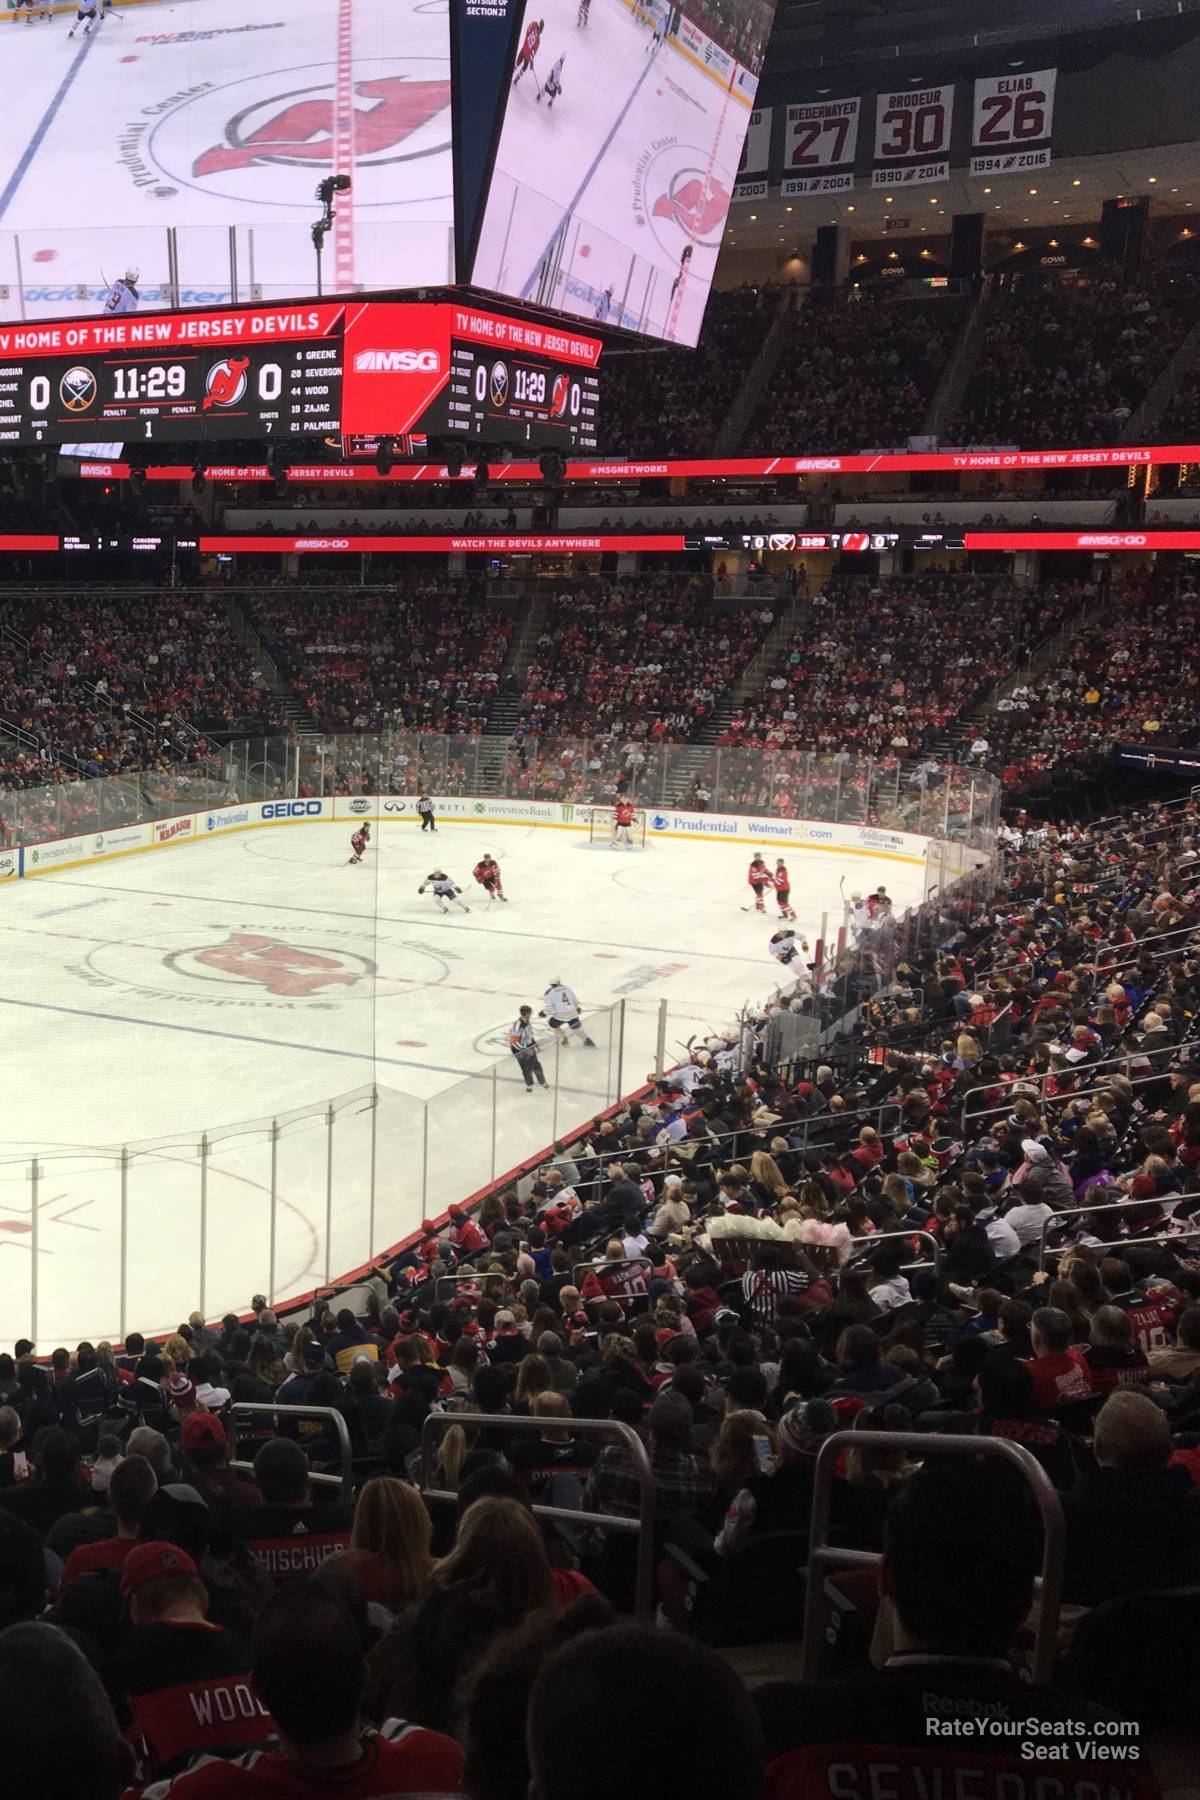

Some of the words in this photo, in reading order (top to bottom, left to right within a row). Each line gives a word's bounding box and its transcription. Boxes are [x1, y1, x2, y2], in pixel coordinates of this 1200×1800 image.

[466, 7, 493, 16] SECTION
[141, 81, 215, 116] Center
[889, 90, 941, 109] BRODEUR
[789, 102, 857, 121] NIEDERMAYER
[980, 91, 1046, 143] 26
[882, 105, 945, 156] 30
[792, 117, 850, 165] 27
[115, 122, 160, 188] Prudential
[974, 160, 1000, 171] 1994
[1018, 153, 1047, 166] 2016
[875, 171, 902, 182] 1990
[918, 166, 945, 179] 2014
[740, 183, 766, 196] 2003
[786, 181, 807, 192] 1991
[823, 177, 851, 190] 2004
[1041, 255, 1066, 265] GOYA
[15, 331, 60, 348] HOME
[66, 329, 89, 346] OF
[93, 326, 126, 343] THE
[131, 323, 172, 342] NEW
[177, 318, 246, 338] JERSEY
[251, 313, 319, 334] DEVILS
[456, 313, 468, 331] TV
[470, 317, 494, 337] HOME
[495, 322, 507, 339] OF
[508, 325, 523, 344] THE
[525, 329, 542, 348] NEW
[543, 333, 569, 354] JERSEY
[570, 340, 594, 360] DEVILS
[306, 350, 337, 360] GREENE
[370, 350, 438, 371] MSG
[305, 368, 343, 377] SEVERSON
[114, 365, 186, 399] 11:29
[258, 363, 282, 400] 0
[475, 365, 487, 401] 0
[515, 369, 546, 403] 11:29
[30, 376, 50, 410] 0
[290, 387, 301, 395] 44
[305, 385, 329, 395] WOOD
[570, 383, 580, 416] 0
[103, 409, 127, 417] PENALTY
[172, 406, 196, 414] PENALTY
[291, 405, 301, 413] 19
[304, 404, 330, 413] ZAJAC
[145, 421, 152, 438] 1
[265, 423, 272, 433] 7
[290, 423, 300, 431] 21
[303, 421, 341, 431] PALMIERI
[36, 431, 43, 440] 6
[806, 459, 840, 470] MSG
[953, 457, 967, 466] TV
[970, 456, 1000, 466] HOME
[1004, 456, 1017, 465] OF
[1020, 455, 1040, 465] THE
[1043, 454, 1067, 463] NEW
[1070, 452, 1108, 463] JERSEY
[1111, 451, 1150, 461] DEVILS
[86, 466, 112, 475] MSG
[211, 468, 236, 476] HOME
[238, 468, 249, 476] OF
[250, 468, 267, 476] THE
[290, 468, 321, 477] JERSEY
[324, 468, 354, 477] DEVILS
[590, 464, 668, 476] @MSGNETWORKS
[452, 539, 483, 548] WATCH
[486, 539, 506, 548] THE
[508, 539, 543, 547] DEVILS
[544, 538, 600, 547] ANYWHERE
[755, 537, 763, 548] 0
[801, 536, 826, 547] 11:29
[875, 535, 885, 547] 0
[262, 801, 322, 819] GEICO
[216, 810, 248, 826] Prudential
[673, 817, 738, 833] Prudential
[748, 822, 792, 836] Walmart
[1133, 1310, 1162, 1326] ZAJAC
[922, 1692, 1010, 1720] Reebok
